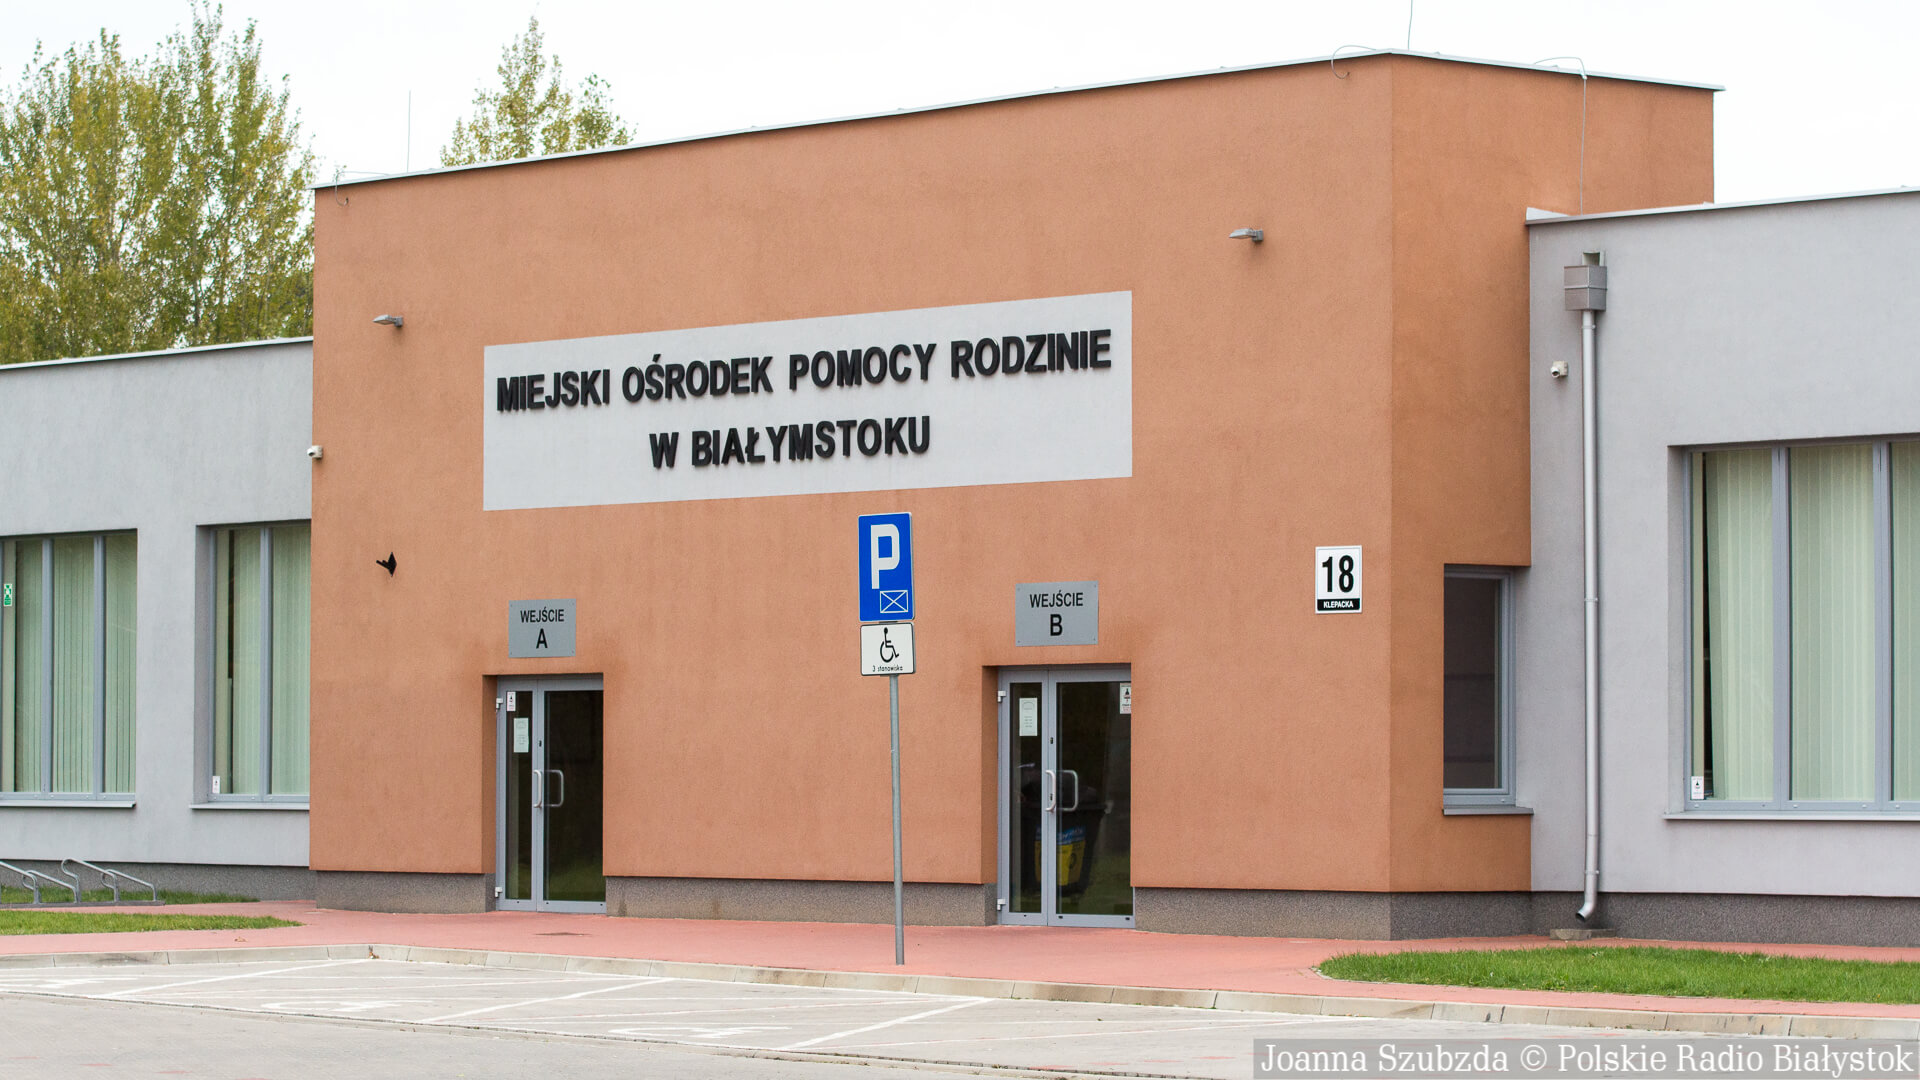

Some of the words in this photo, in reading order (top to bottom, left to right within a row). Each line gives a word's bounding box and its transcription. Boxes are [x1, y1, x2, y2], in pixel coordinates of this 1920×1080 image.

[496, 368, 611, 412] MIEJSKI
[622, 354, 774, 402] OŚRODEK
[789, 343, 937, 391] POMOCY
[950, 328, 1112, 380] RODZINIE
[648, 431, 680, 469] W
[691, 415, 930, 467] BIAŁYMSTOKU
[870, 524, 900, 589] P
[1322, 555, 1354, 593] 18
[520, 606, 565, 623] WEJŚCIE
[1029, 589, 1084, 609] WEJŚCIE
[535, 627, 549, 650] A
[1049, 613, 1063, 637] B
